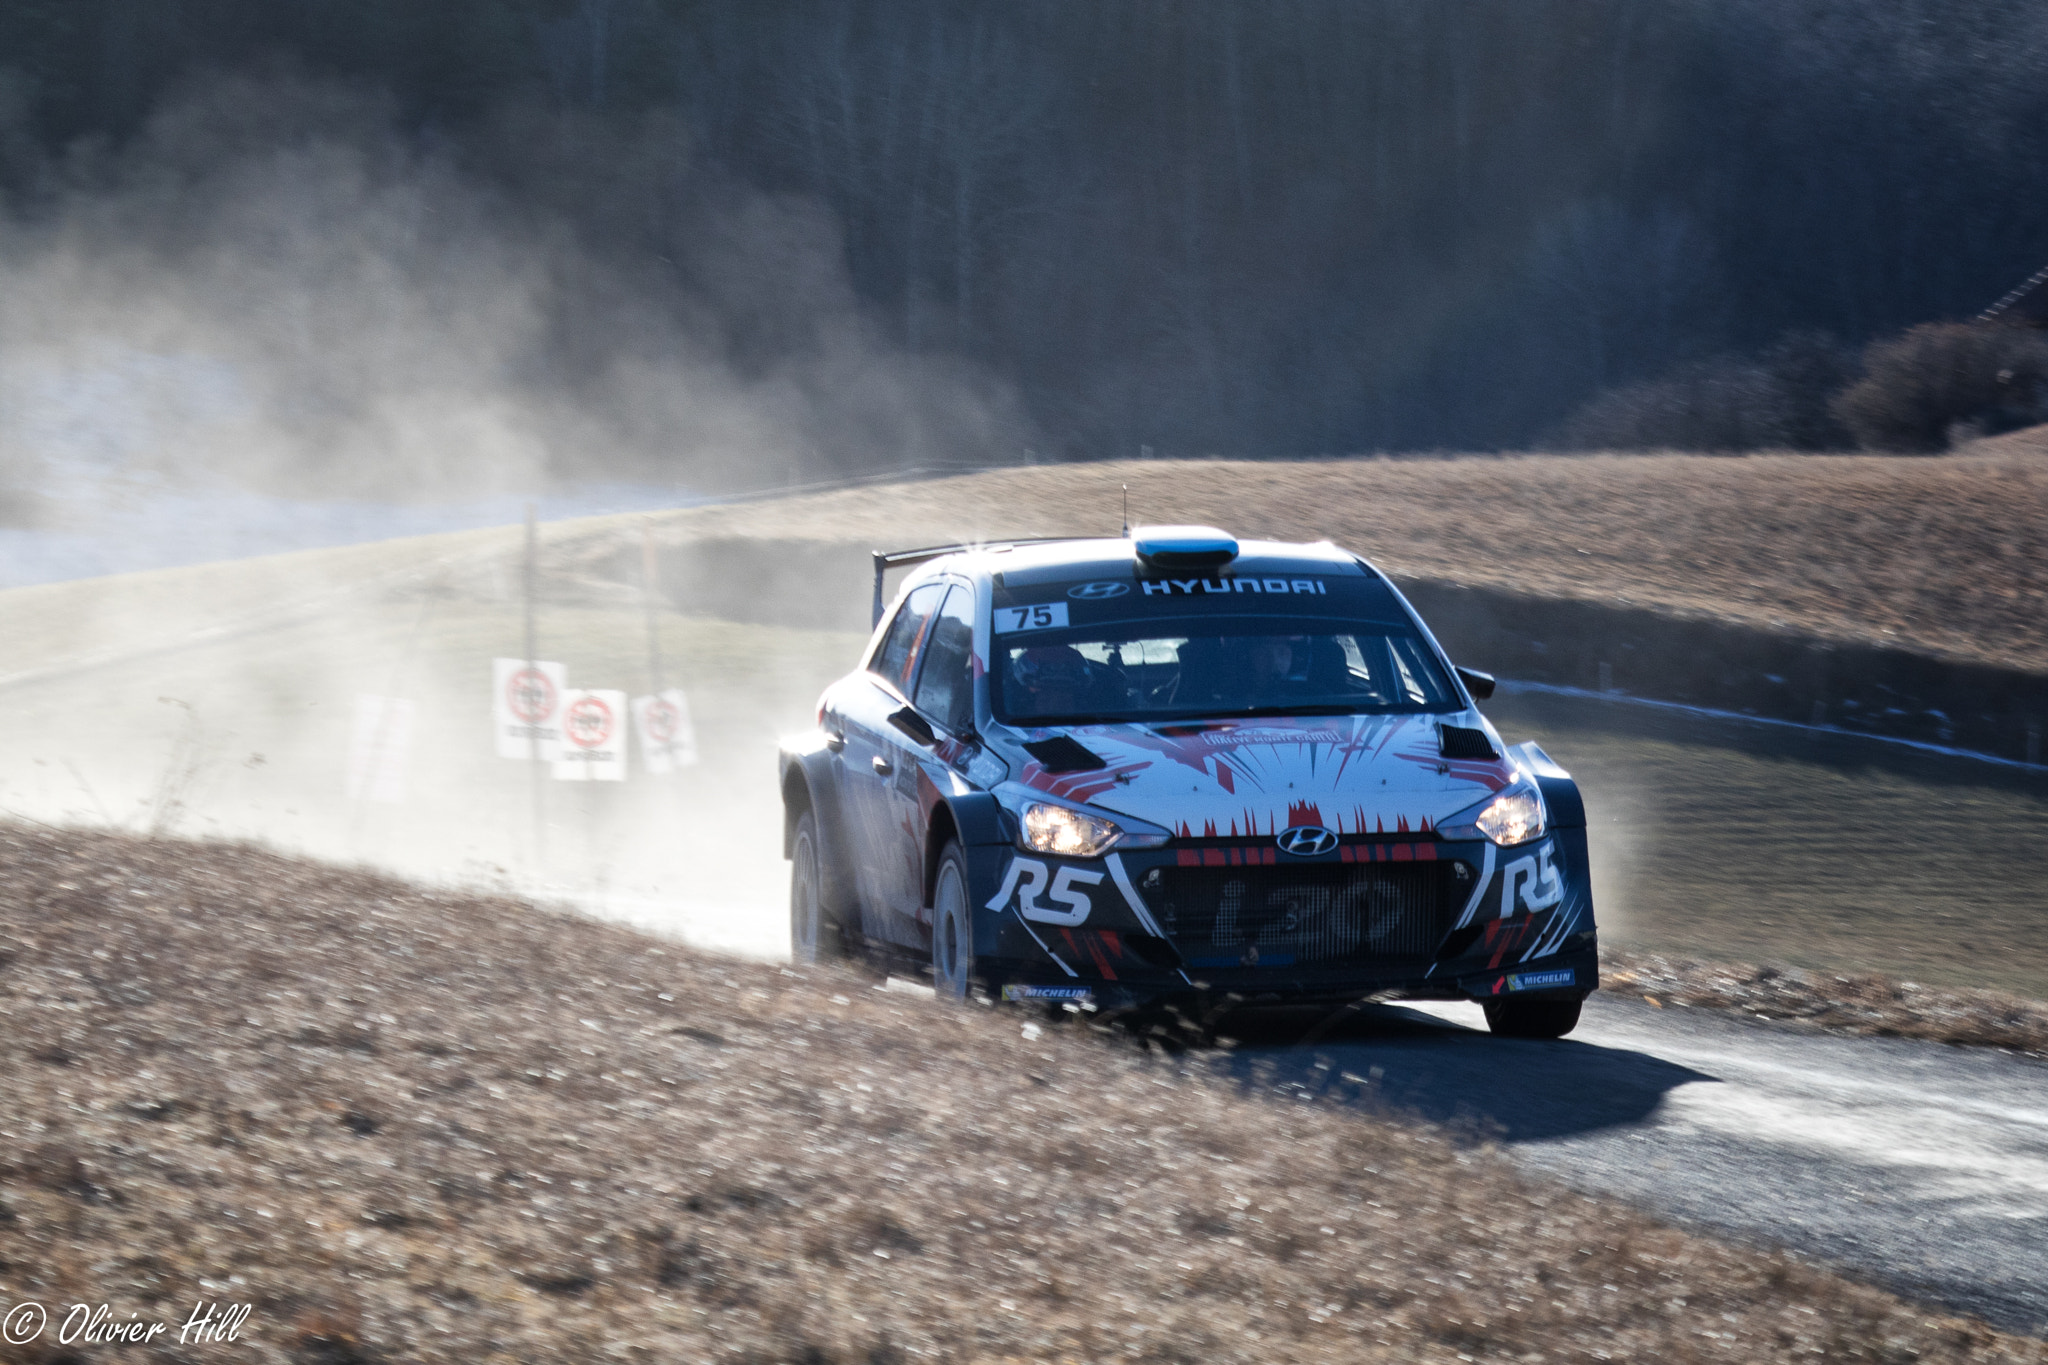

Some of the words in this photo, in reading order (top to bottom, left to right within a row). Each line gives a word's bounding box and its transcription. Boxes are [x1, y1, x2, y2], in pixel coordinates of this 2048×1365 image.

[1141, 579, 1326, 595] HYUNDAI
[1012, 606, 1052, 629] 75
[1500, 840, 1565, 919] R5
[984, 857, 1104, 927] R5
[1524, 972, 1571, 985] MICHELIN
[1025, 988, 1086, 999] MICHELIN
